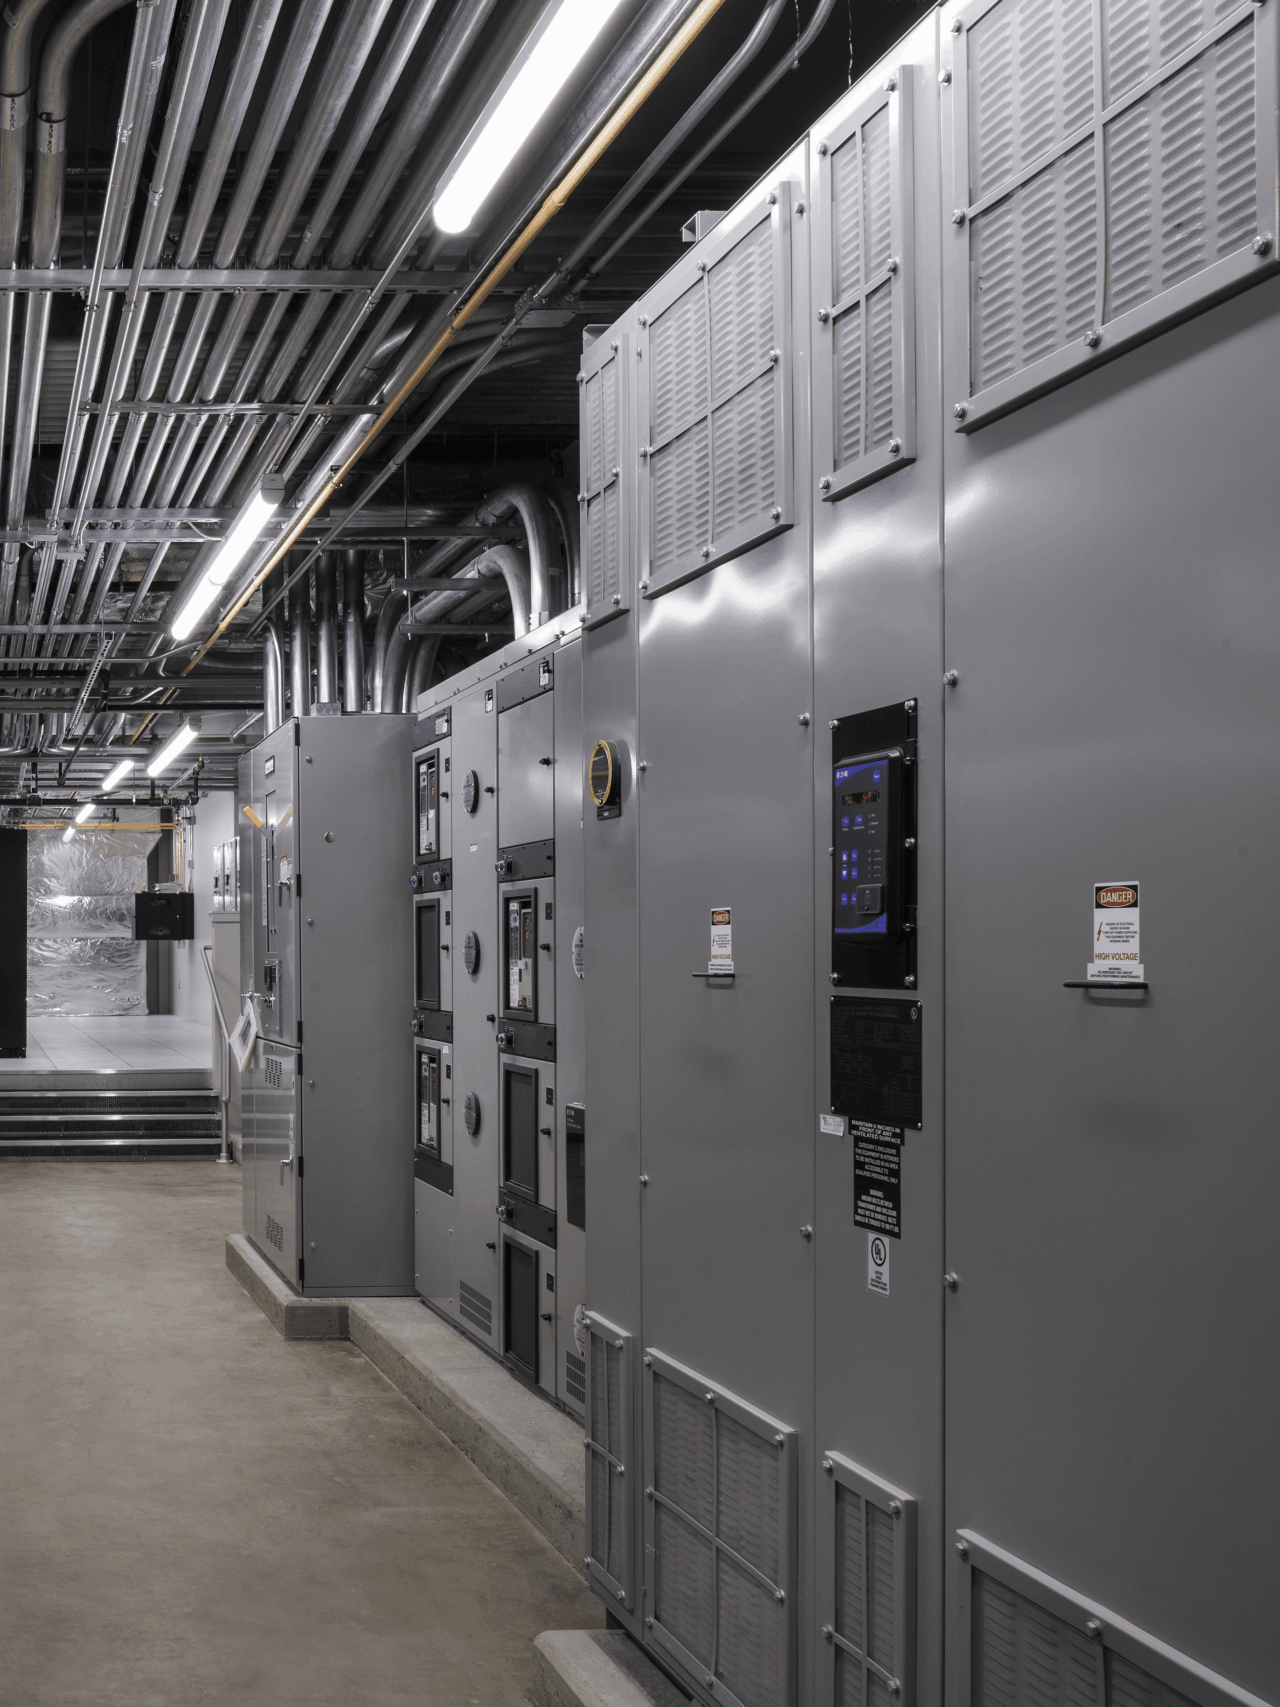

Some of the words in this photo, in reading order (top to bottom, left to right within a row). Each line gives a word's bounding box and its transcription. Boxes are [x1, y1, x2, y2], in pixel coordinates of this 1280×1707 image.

[1100, 891, 1133, 903] DANGER
[851, 1120, 873, 1128] MAINTAIN
[851, 1130, 878, 1140] VENTILATED
[879, 1135, 901, 1144] SURFACE
[862, 1150, 880, 1158] EQUIPMENT
[884, 1154, 899, 1163] INTENDED
[878, 1146, 896, 1155] ENCLOSURE
